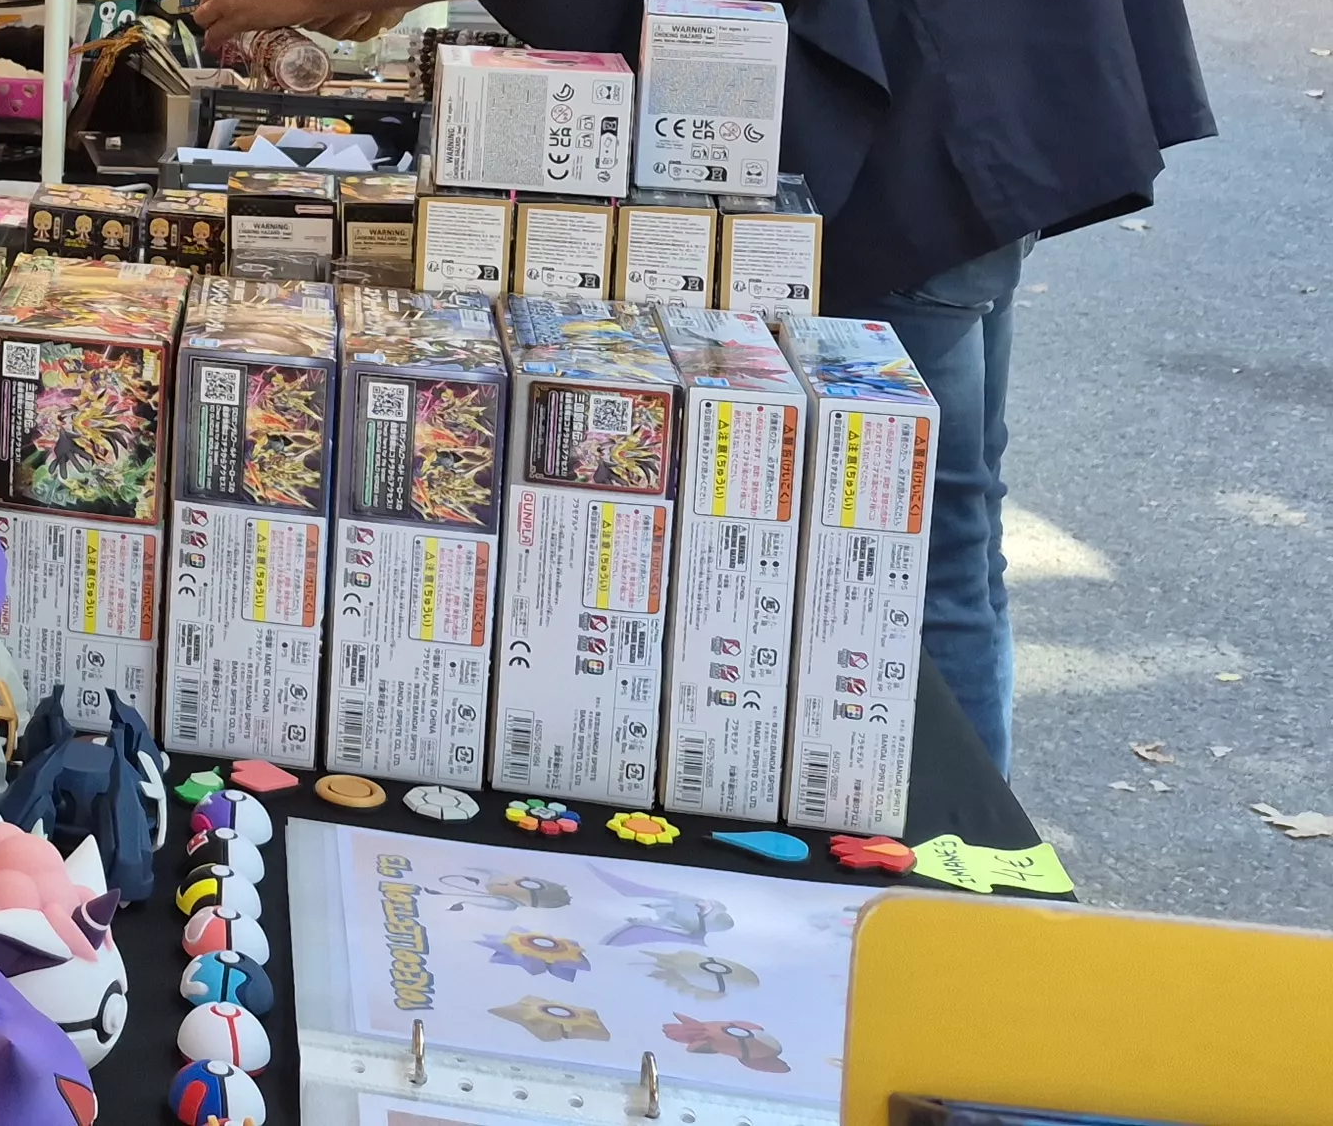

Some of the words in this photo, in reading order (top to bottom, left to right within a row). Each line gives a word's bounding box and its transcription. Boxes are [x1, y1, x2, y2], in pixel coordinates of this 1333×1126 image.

[671, 25, 715, 35] WARNING:
[693, 119, 715, 130] UK
[548, 126, 560, 147] UK
[560, 127, 572, 148] CA
[692, 129, 715, 141] CA
[446, 126, 455, 164] WARNING:
[253, 223, 290, 231] WARNING:
[369, 229, 407, 237] WARNING:
[521, 493, 534, 544] GUNPLA
[379, 880, 435, 1012] POKECOLLECTION
